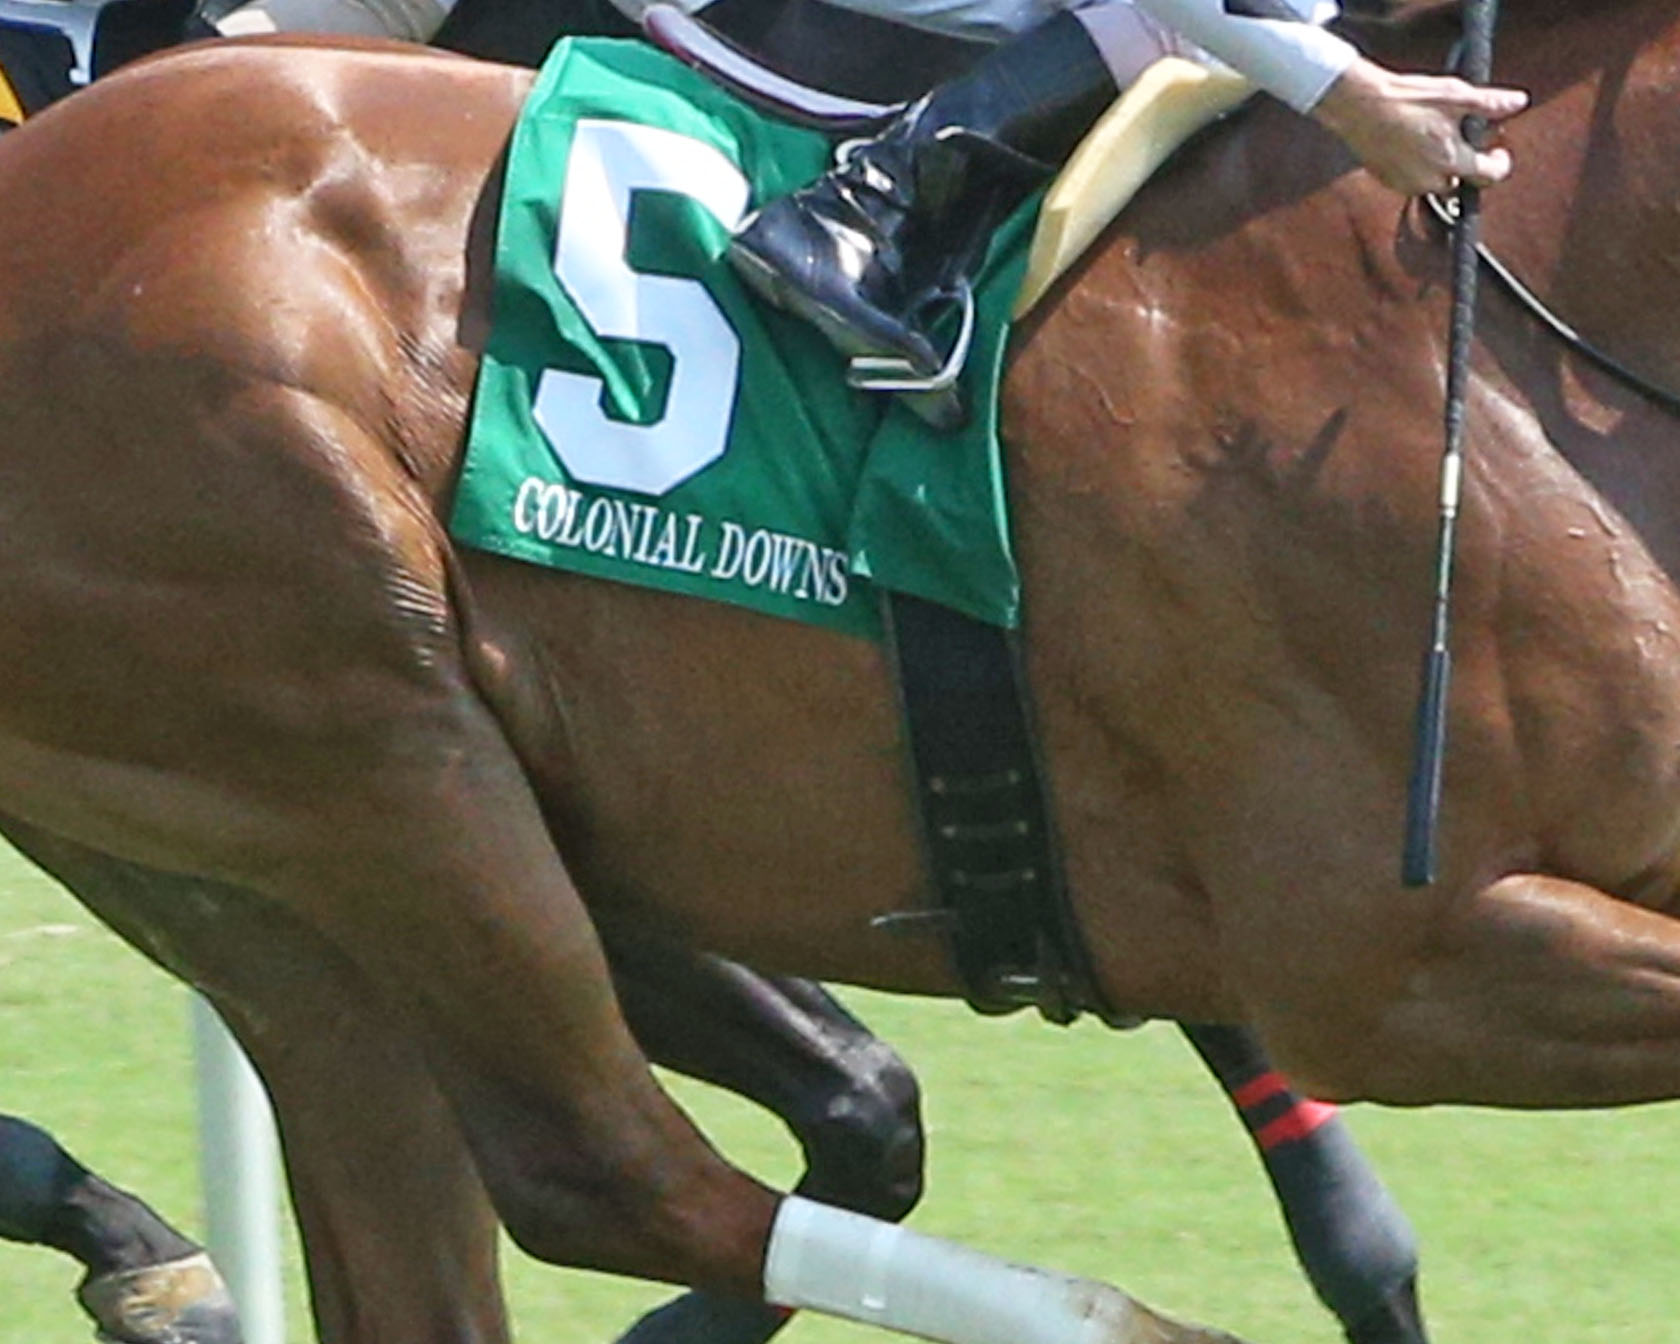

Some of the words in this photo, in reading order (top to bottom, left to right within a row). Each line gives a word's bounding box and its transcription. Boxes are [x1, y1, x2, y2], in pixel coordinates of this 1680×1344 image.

[533, 119, 750, 496] 5
[514, 476, 706, 573] COLONIAL
[711, 522, 848, 606] DOWNS
